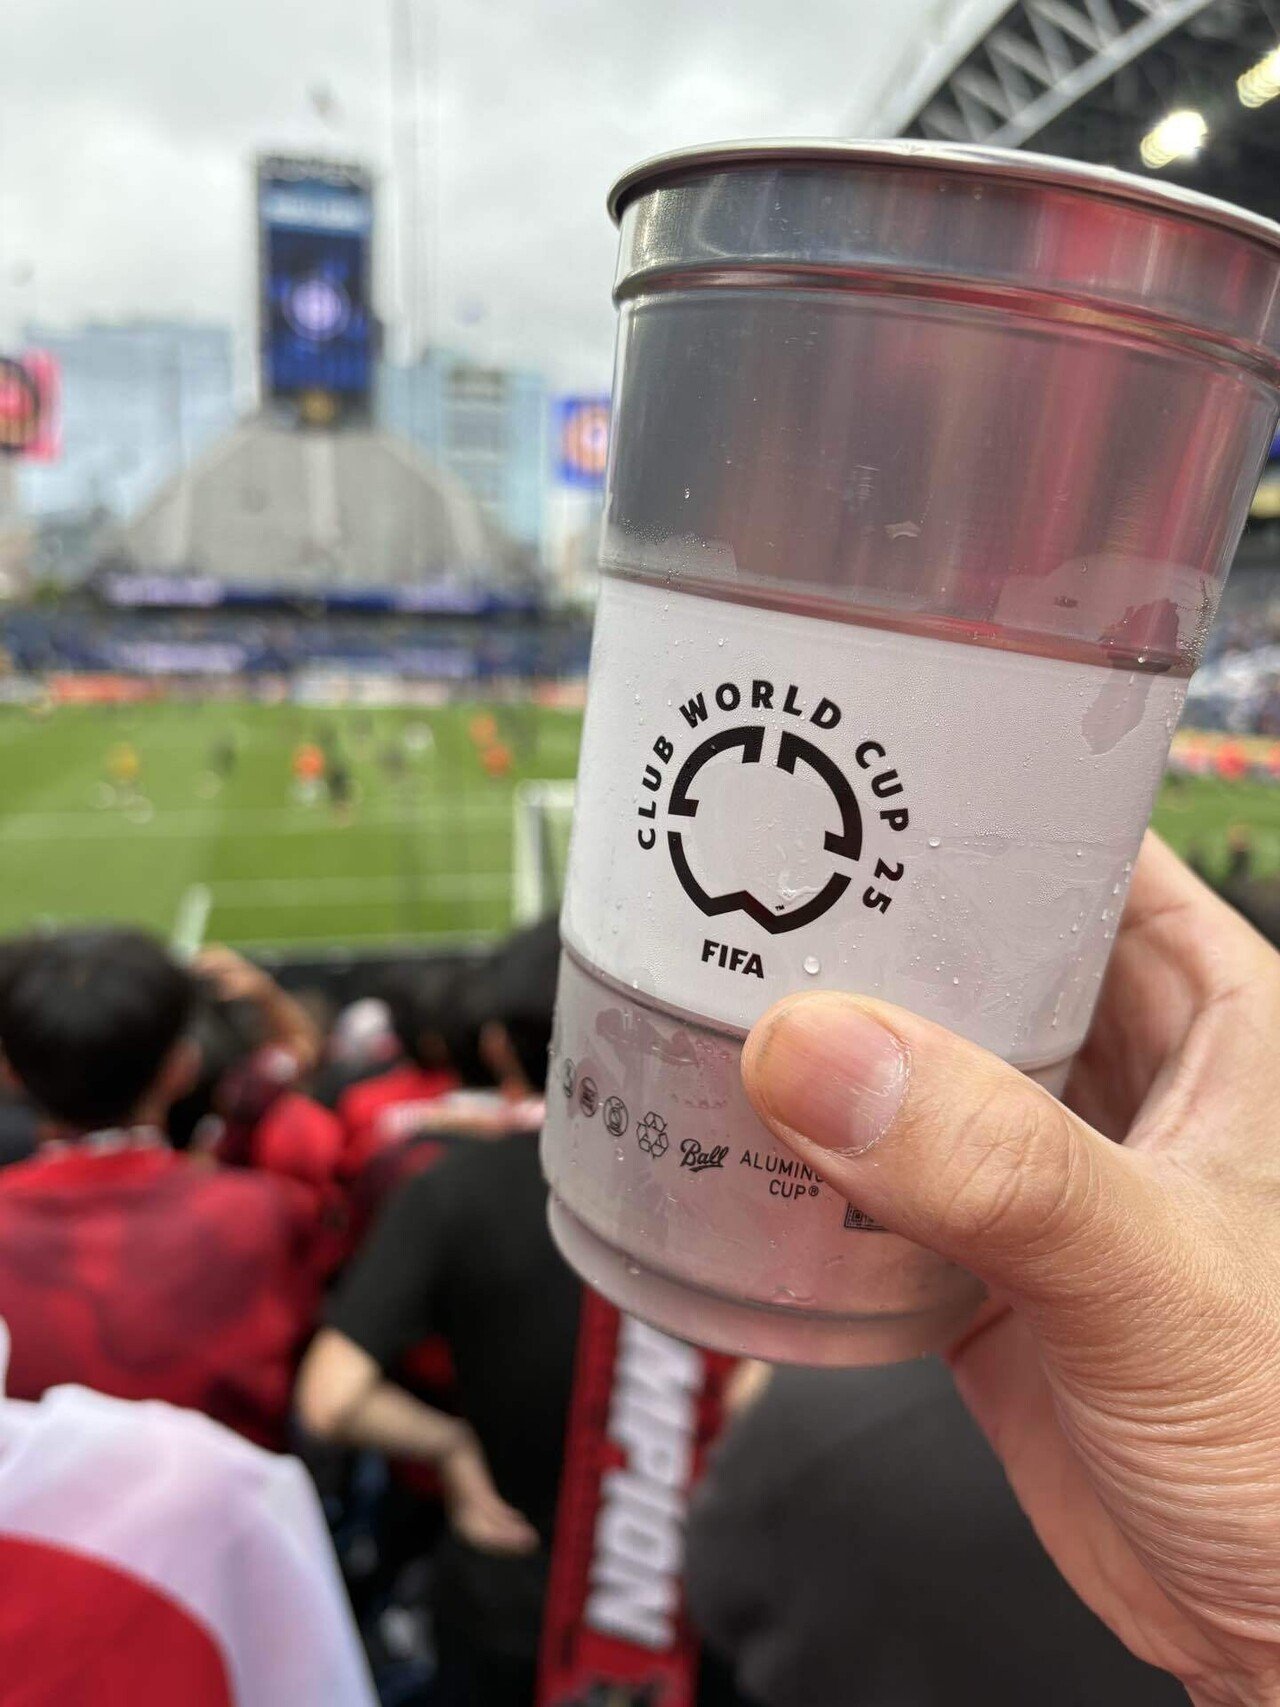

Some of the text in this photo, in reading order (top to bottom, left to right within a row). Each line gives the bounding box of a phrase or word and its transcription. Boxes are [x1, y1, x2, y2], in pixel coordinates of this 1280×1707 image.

[637, 679, 910, 915] CLUB WORLD CUP 25
[701, 938, 765, 979] FIFA
[679, 1138, 729, 1172] Ball
